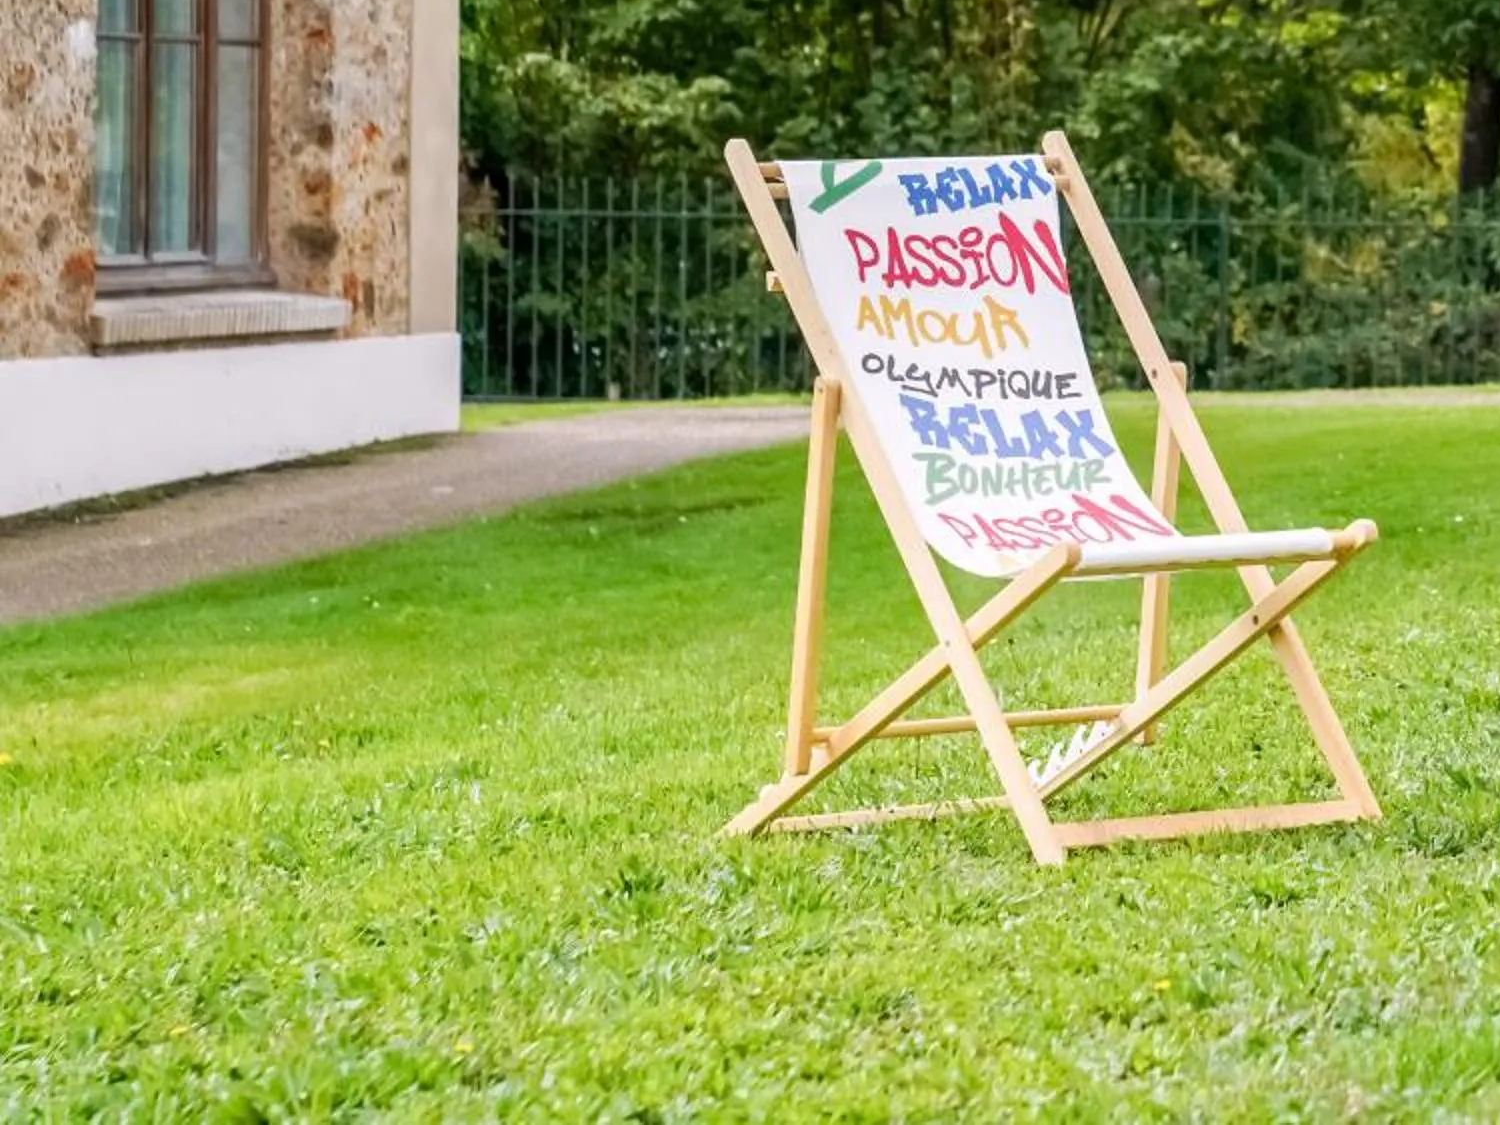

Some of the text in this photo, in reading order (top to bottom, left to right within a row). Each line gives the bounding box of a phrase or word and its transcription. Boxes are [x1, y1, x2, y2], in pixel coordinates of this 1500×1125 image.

[898, 158, 1051, 216] RELAX
[856, 295, 1030, 359] AMOUR
[898, 393, 1115, 460] RELAX
[912, 453, 1112, 505] BONHEUR
